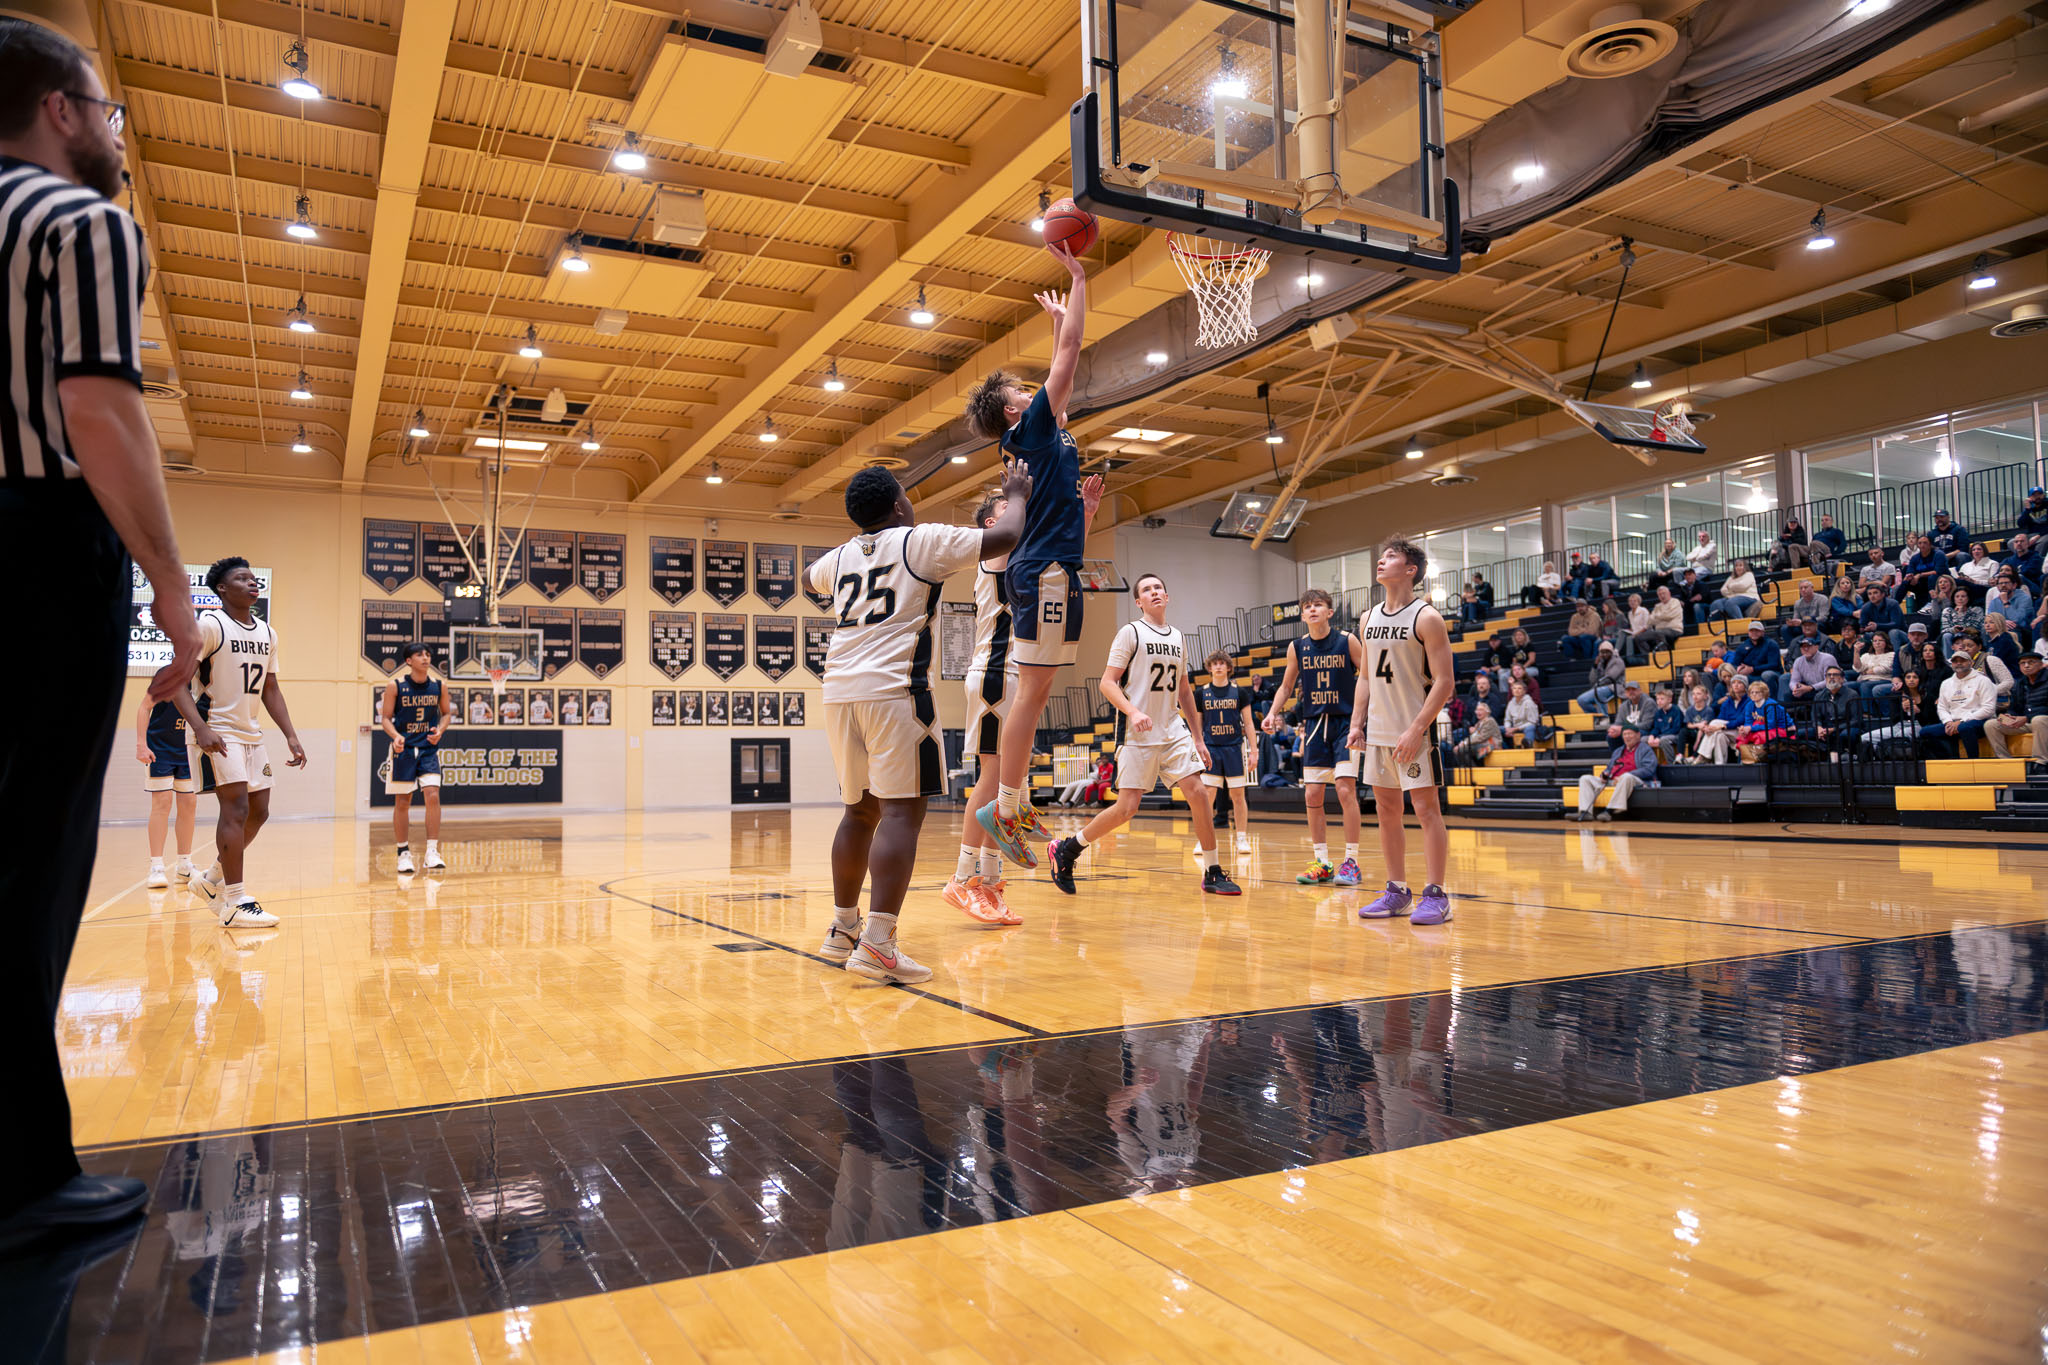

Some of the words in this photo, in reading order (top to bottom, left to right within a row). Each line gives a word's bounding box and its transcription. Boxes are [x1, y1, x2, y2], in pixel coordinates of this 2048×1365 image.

[837, 563, 897, 629] 25
[1043, 602, 1064, 623] ES
[1366, 626, 1410, 640] BURKE
[230, 640, 269, 656] BURKE
[1146, 643, 1181, 658] BURKE
[1302, 655, 1345, 670] ELKHORN
[1376, 648, 1394, 684] 4
[240, 663, 264, 694] 12
[1150, 663, 1177, 692] 23
[1316, 671, 1330, 688] 14
[402, 695, 438, 707] ELKHORN
[1205, 699, 1238, 710] ELKHORN
[1311, 691, 1339, 705] SOUTH
[416, 707, 424, 722] 3
[1220, 711, 1224, 724] 1
[407, 722, 430, 733] SOUTH
[1211, 724, 1234, 736] SOUTH
[488, 748, 516, 766] OF
[518, 748, 558, 766] THE
[442, 768, 544, 786] BULLDOGS
